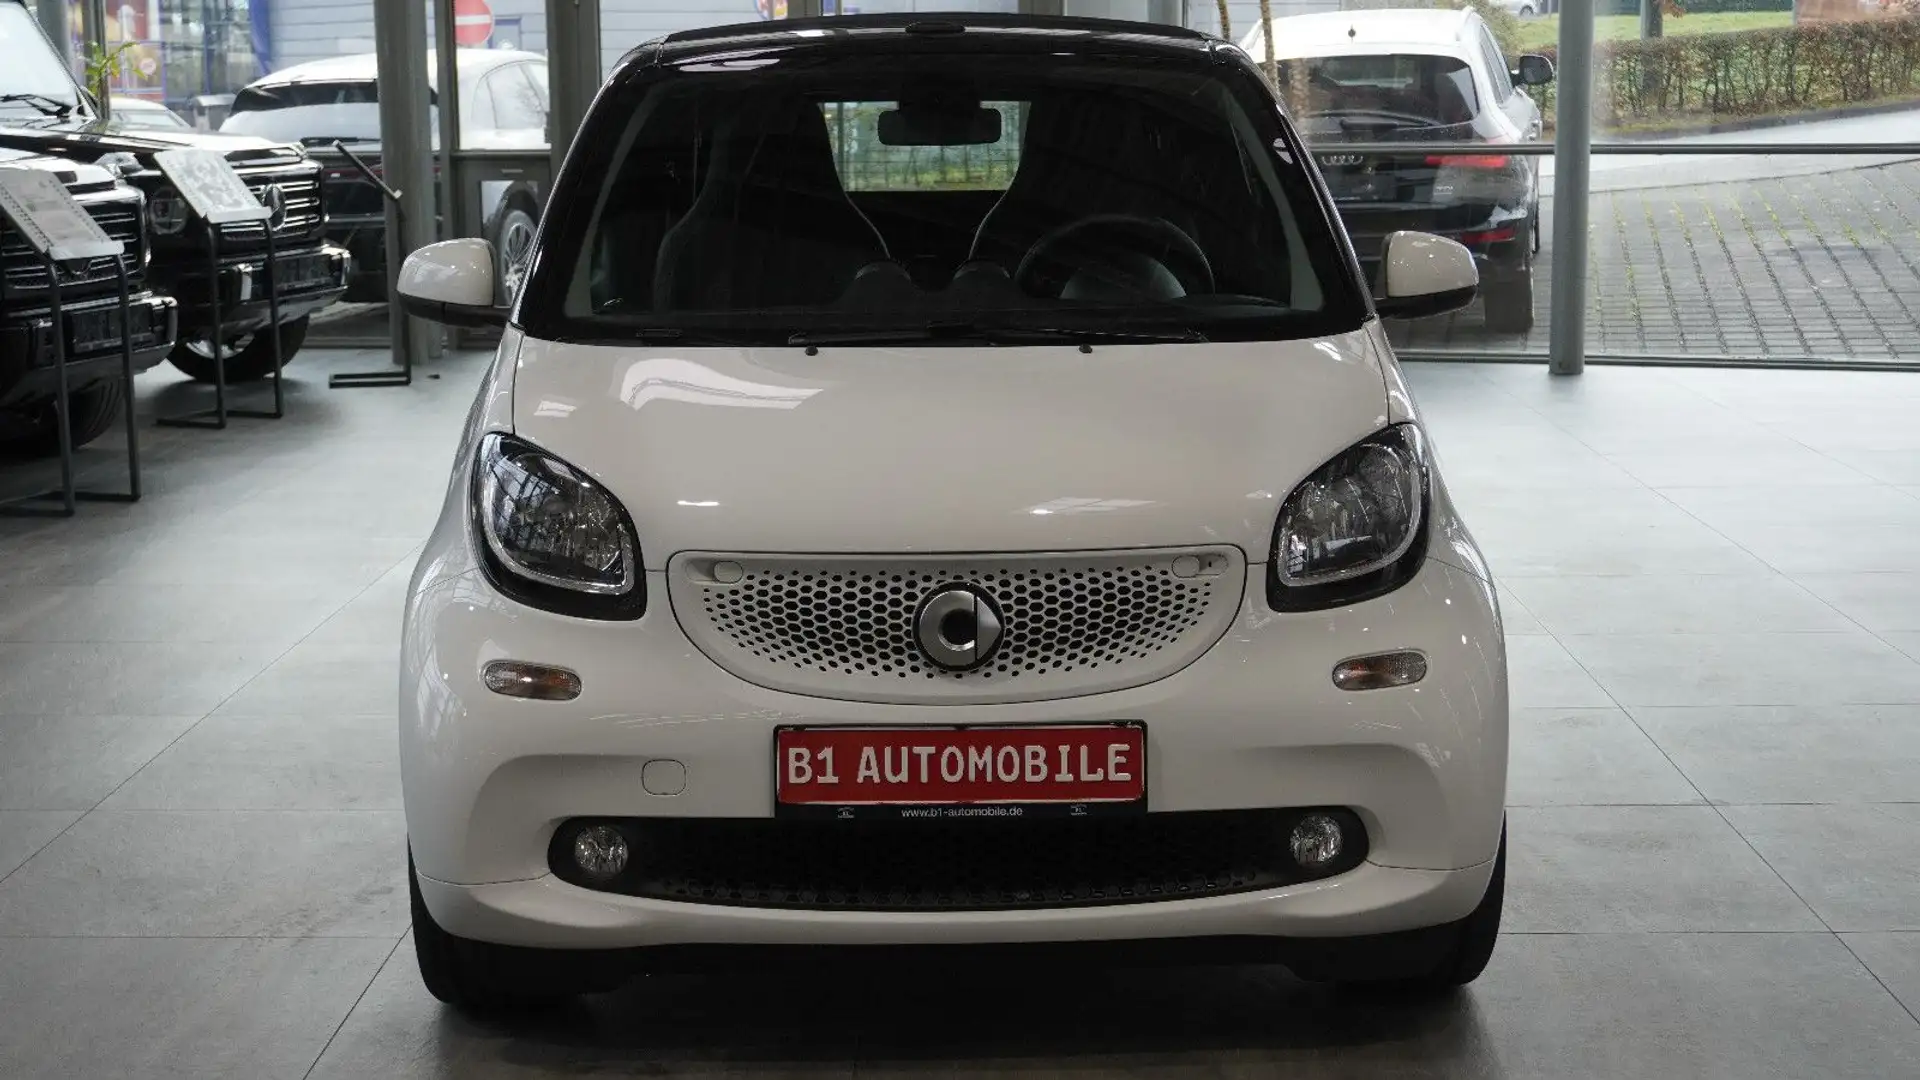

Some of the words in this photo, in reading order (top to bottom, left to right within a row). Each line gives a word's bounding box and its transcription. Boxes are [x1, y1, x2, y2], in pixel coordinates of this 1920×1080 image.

[788, 747, 839, 784] B1
[857, 743, 1132, 784] AUTOMOBILE
[901, 806, 1023, 818] www.b1-automobile.de
